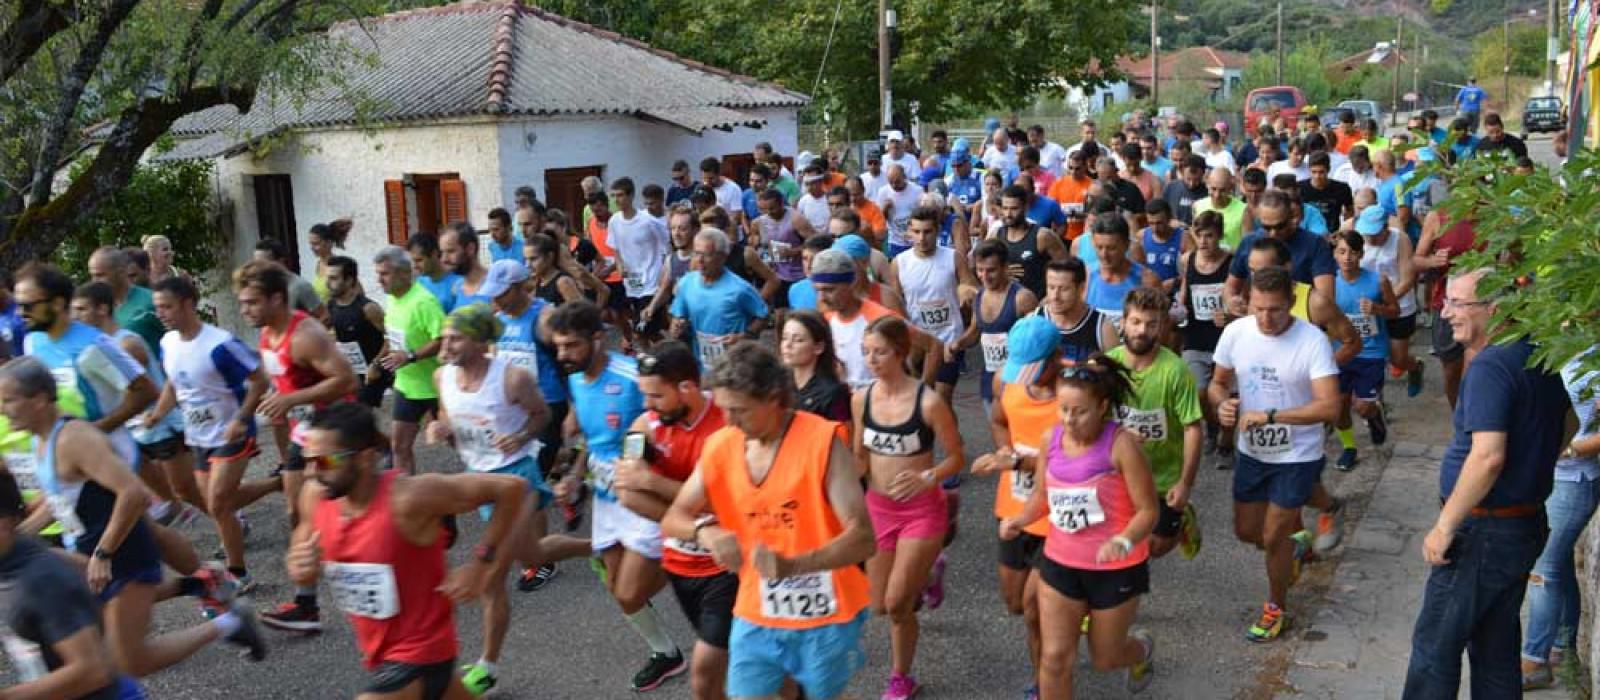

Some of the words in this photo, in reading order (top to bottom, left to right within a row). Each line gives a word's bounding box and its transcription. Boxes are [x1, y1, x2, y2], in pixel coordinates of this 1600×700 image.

[921, 307, 950, 325] 1337
[1246, 426, 1289, 447] 1322
[768, 592, 830, 616] 1129
